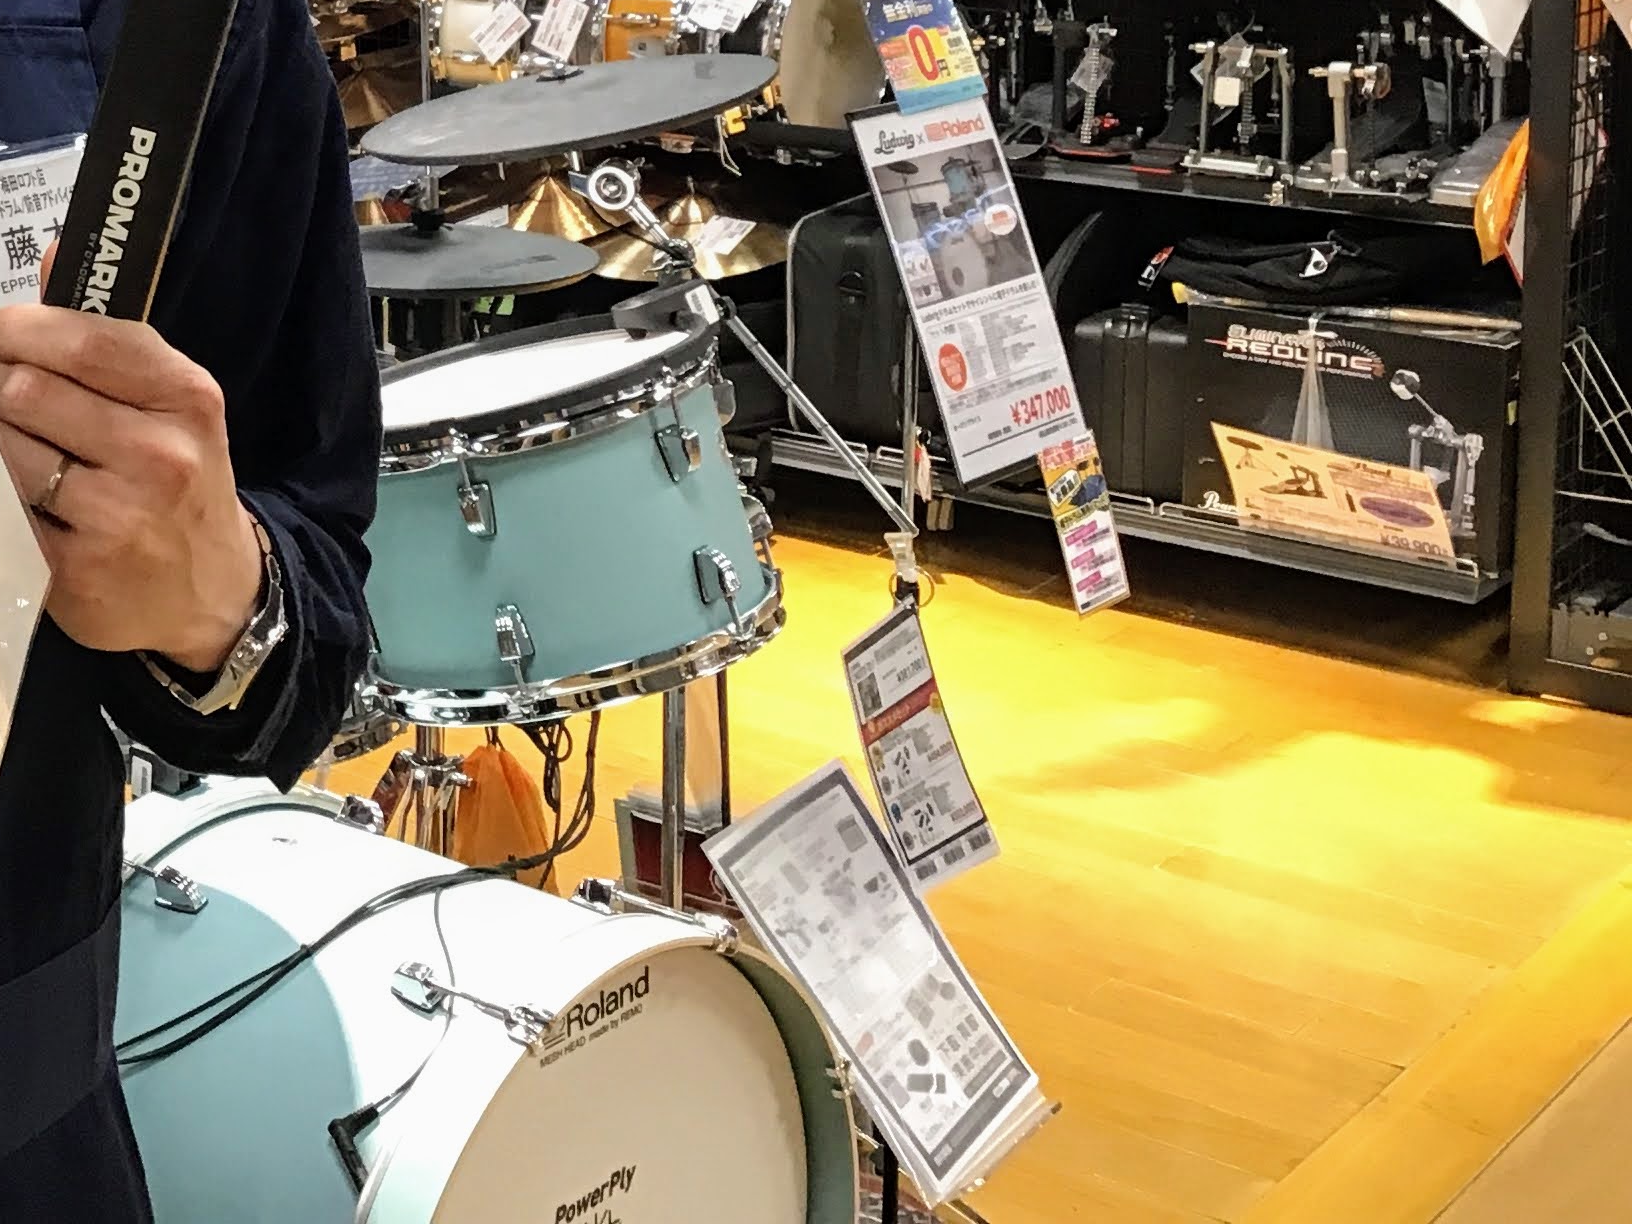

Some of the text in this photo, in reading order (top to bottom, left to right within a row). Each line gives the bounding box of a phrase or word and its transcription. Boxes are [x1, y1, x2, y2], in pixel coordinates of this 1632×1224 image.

[874, 129, 916, 155] Ludwig
[942, 114, 986, 138] Roland
[80, 126, 157, 317] PROMARK
[1010, 384, 1071, 426] ¥347,000
[566, 965, 650, 1037] Roland
[539, 1003, 643, 1069] MESH HEAD made by REMO
[555, 1164, 637, 1224] PowerPly
